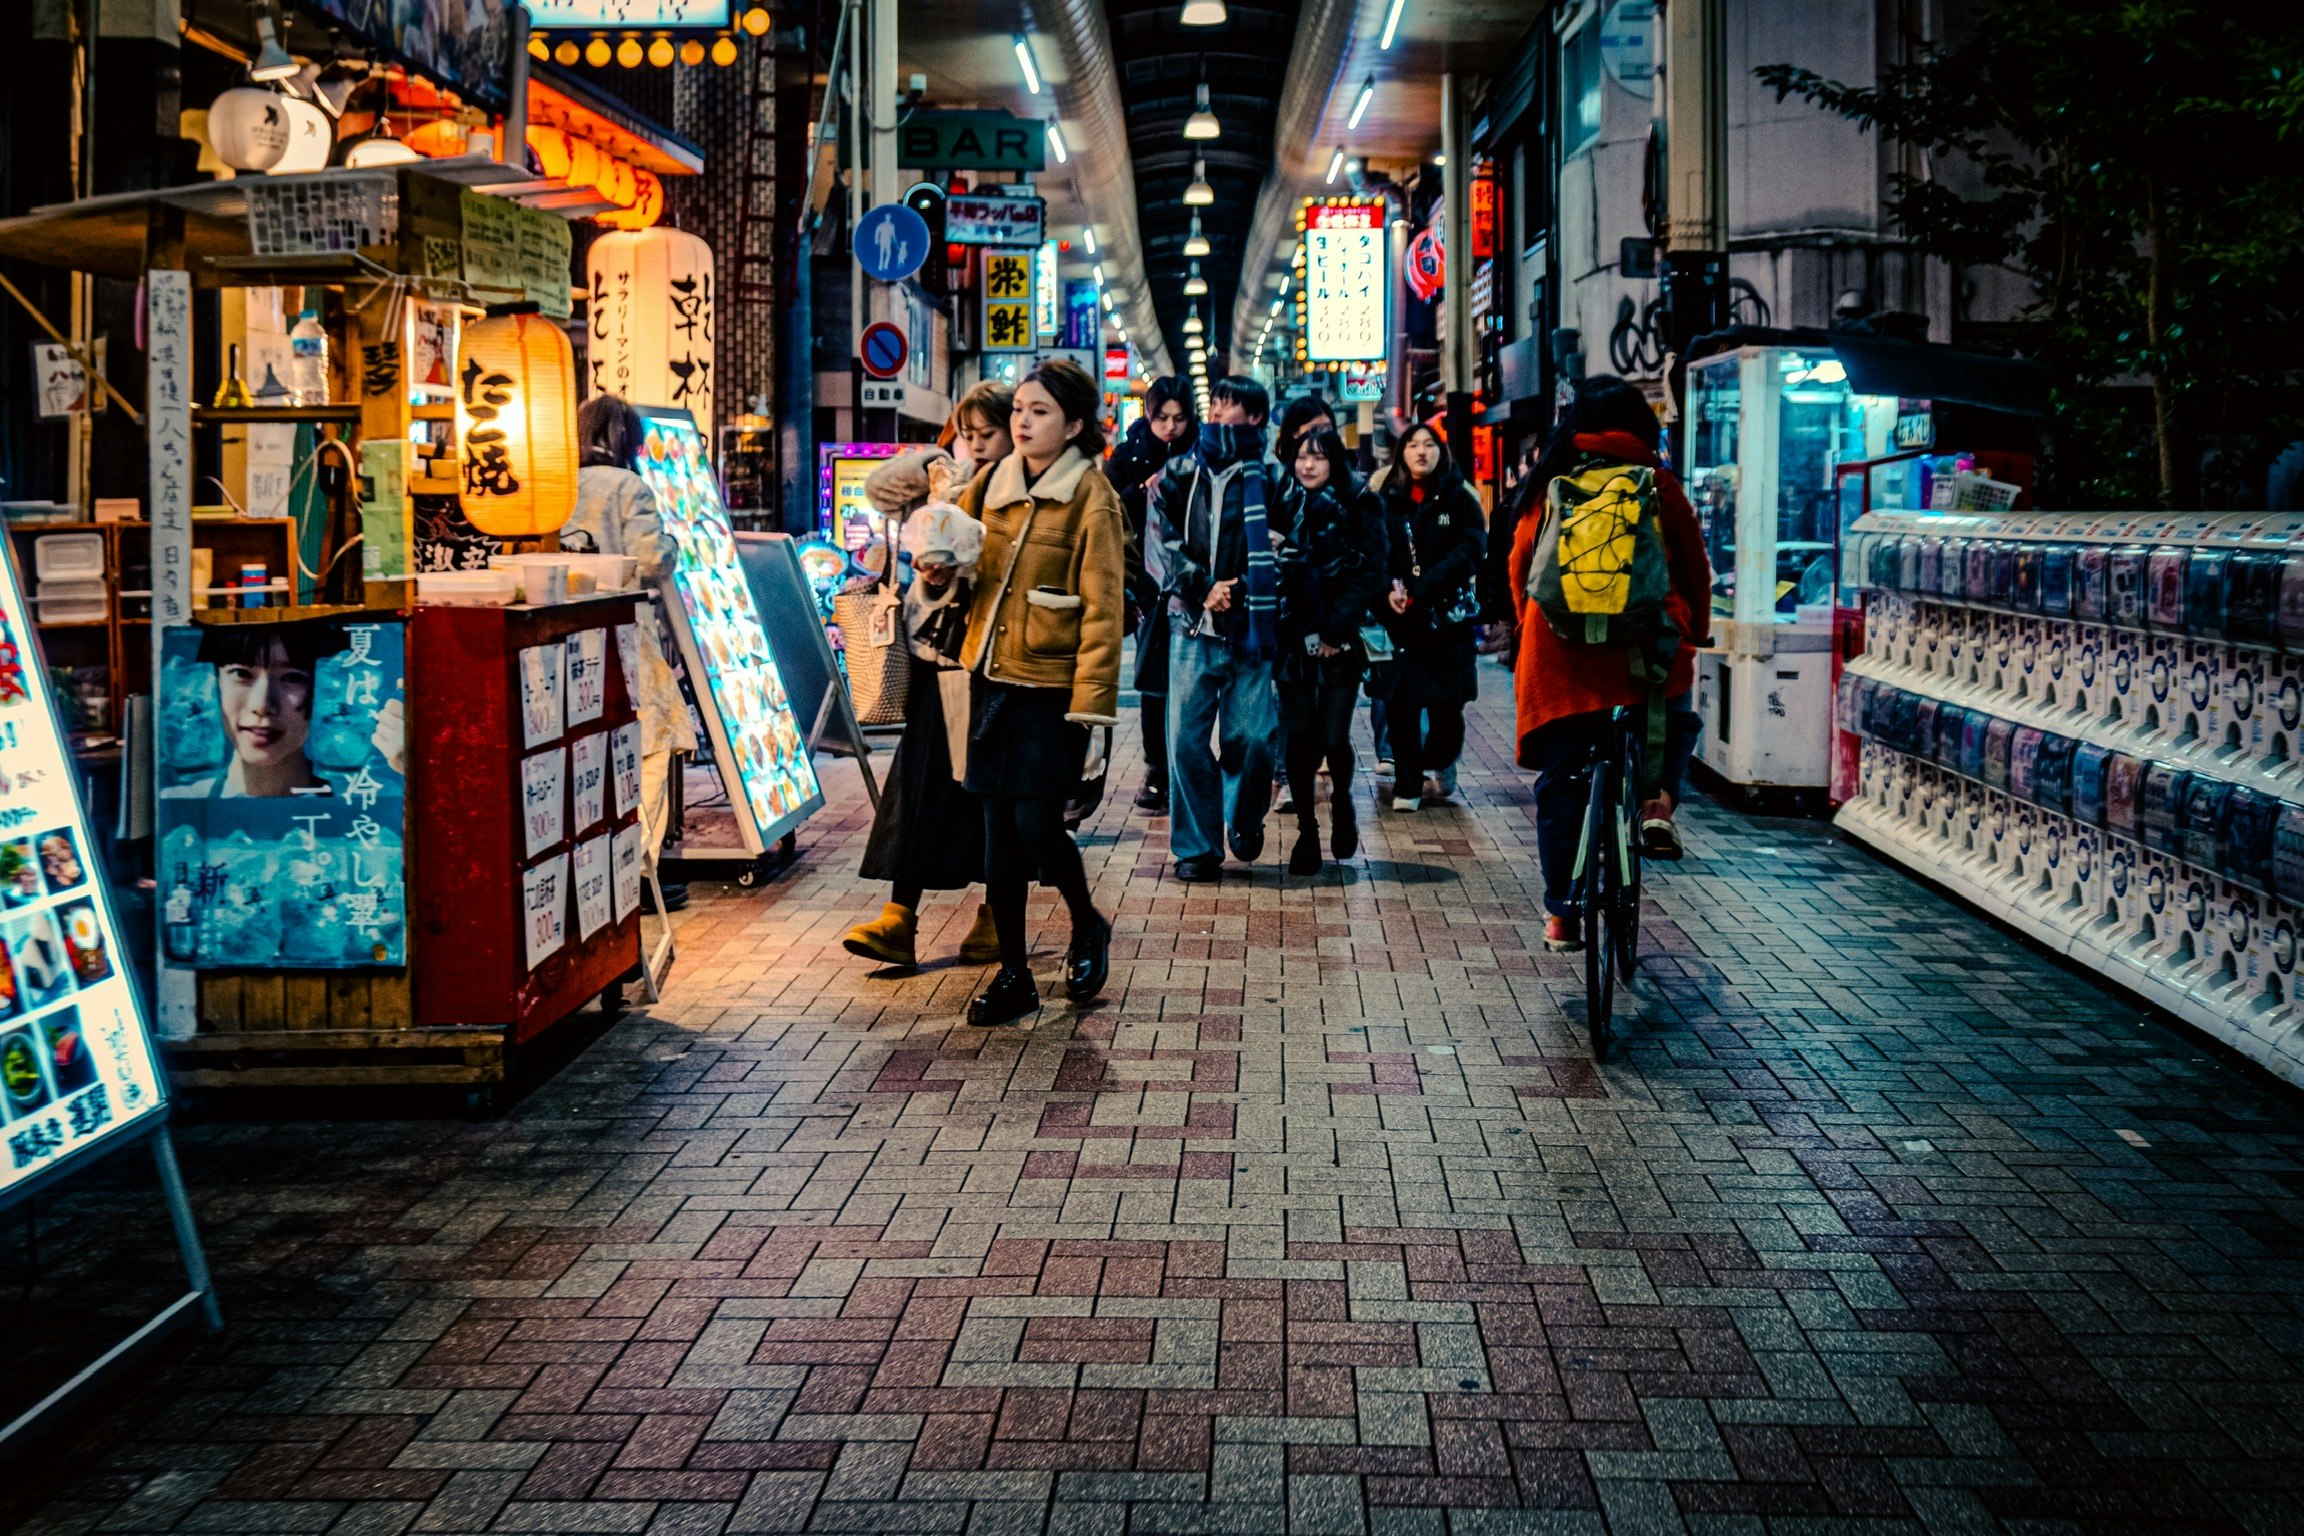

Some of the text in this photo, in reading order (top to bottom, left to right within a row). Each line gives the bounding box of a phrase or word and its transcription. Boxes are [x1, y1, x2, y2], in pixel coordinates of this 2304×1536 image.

[905, 127, 1029, 158] BAR
[864, 388, 904, 401] 自動車
[462, 357, 520, 496] たこ焼
